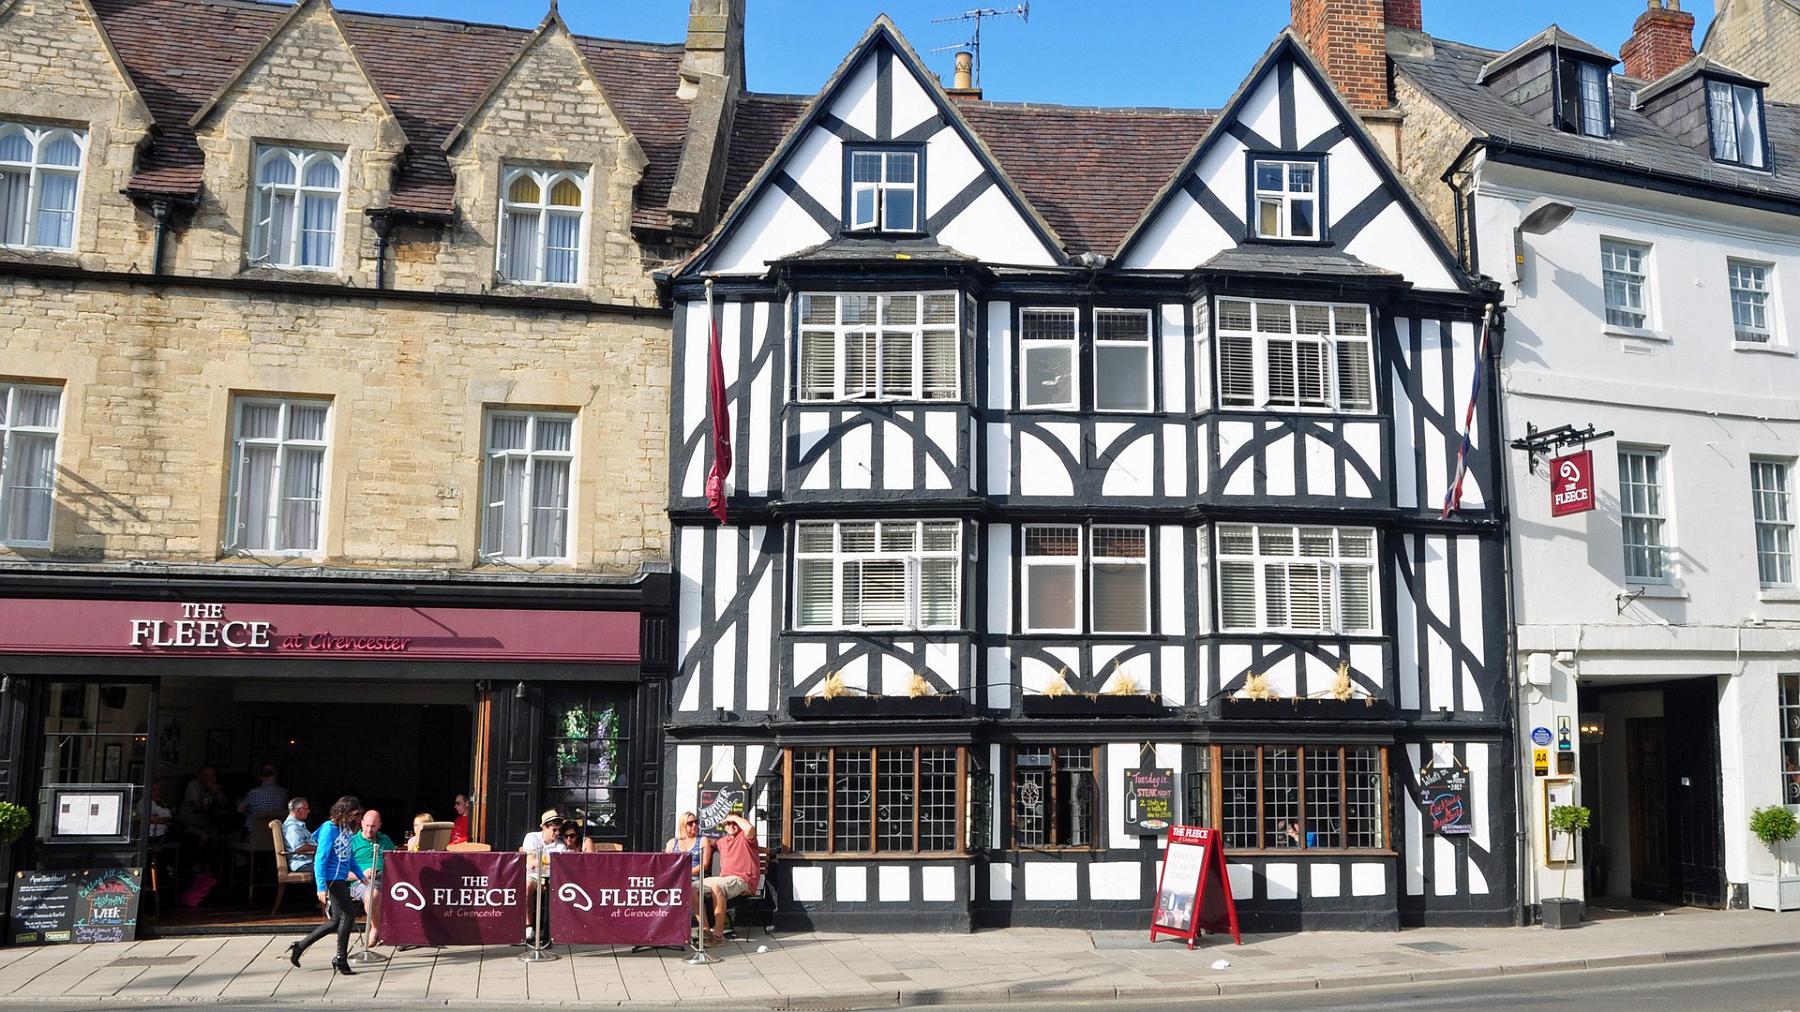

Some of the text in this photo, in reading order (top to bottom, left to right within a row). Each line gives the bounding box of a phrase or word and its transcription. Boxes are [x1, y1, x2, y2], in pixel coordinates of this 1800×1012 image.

[1565, 483, 1576, 491] THE
[1555, 488, 1588, 505] FLEECE
[181, 603, 223, 618] THE
[129, 619, 270, 648] FLEECE
[282, 632, 410, 651] at Cirencester
[1536, 753, 1547, 762] AA
[1137, 788, 1158, 798] STEAK
[1139, 799, 1146, 807] 2
[1173, 827, 1209, 839] THE FLEECE
[461, 876, 488, 887] THE
[628, 876, 655, 887] THE
[433, 889, 517, 906] FLEECE
[600, 889, 682, 906] FLEECE
[94, 907, 120, 919] WEEK
[443, 908, 504, 918] at Cirencester
[611, 908, 670, 918] at Cirencester
